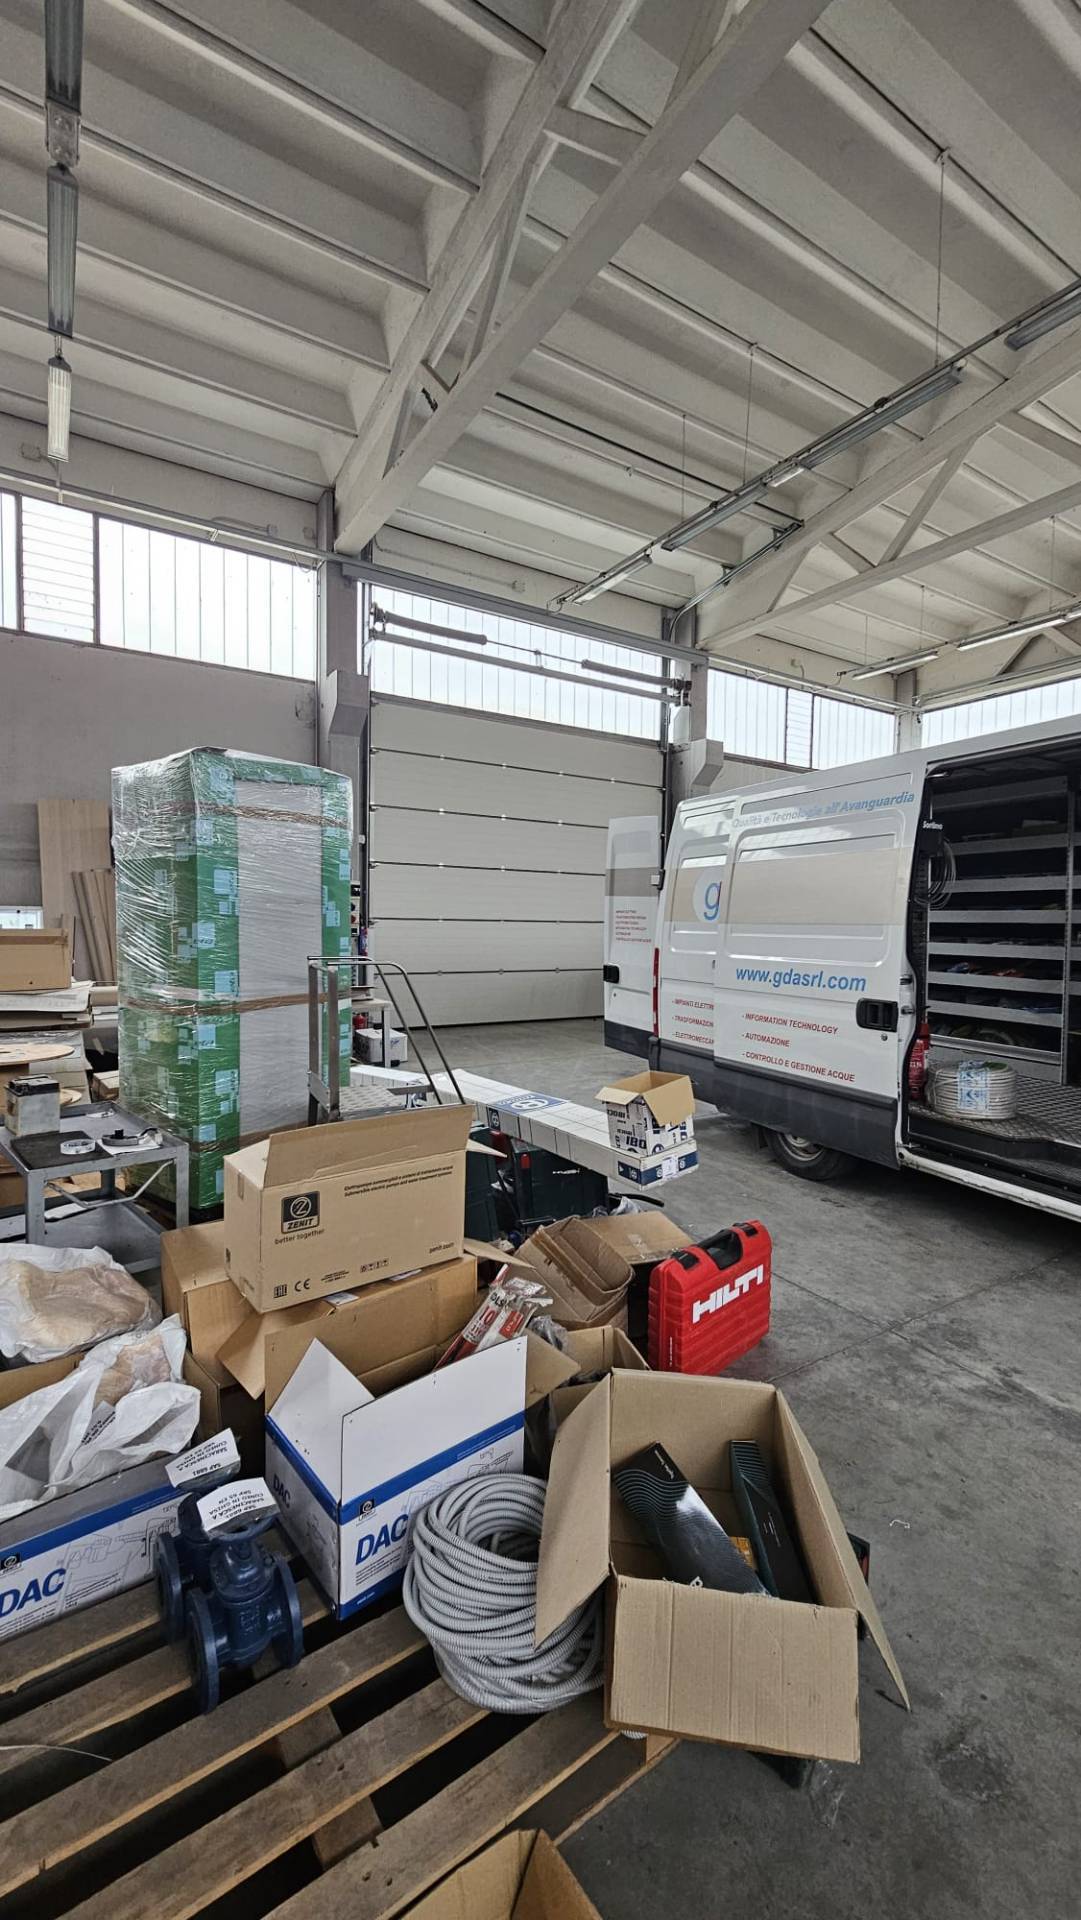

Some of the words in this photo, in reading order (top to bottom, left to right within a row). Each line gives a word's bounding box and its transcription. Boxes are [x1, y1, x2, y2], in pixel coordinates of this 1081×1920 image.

[736, 968, 866, 991] www.gdasrl.com
[745, 1013, 788, 1027] INFORMATION
[789, 1019, 838, 1035] TECHNOLOGY
[745, 1032, 790, 1047] AUTOMAZIONE
[746, 1051, 783, 1066] CONTROLLO
[791, 1061, 826, 1076] GESTIONE
[827, 1069, 855, 1082] ACQUE
[287, 1218, 314, 1230] ZENIT
[275, 1233, 296, 1244] better
[692, 1263, 764, 1325] HILTI
[273, 1473, 291, 1508] DAC
[355, 1513, 409, 1565] DAC
[0, 1567, 66, 1618] DAC
